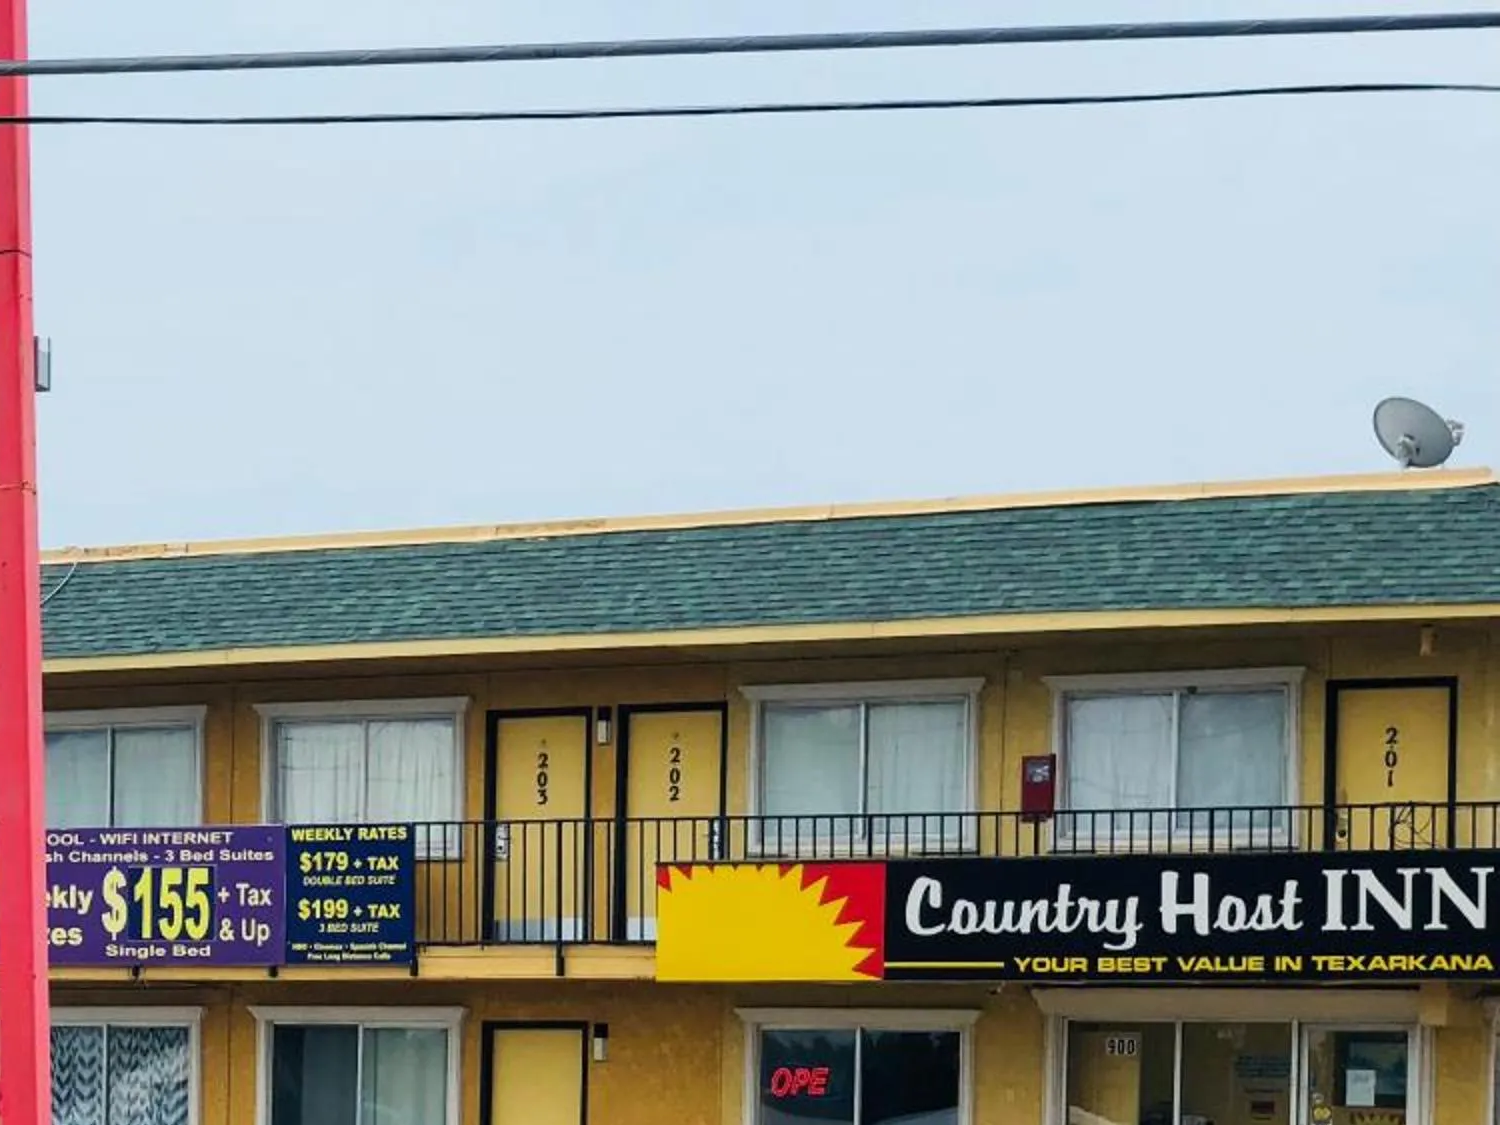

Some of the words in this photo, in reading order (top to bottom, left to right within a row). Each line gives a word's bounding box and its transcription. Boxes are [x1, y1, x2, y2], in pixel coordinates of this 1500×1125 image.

[1385, 727, 1398, 787] 201
[537, 753, 549, 805] 203
[669, 747, 681, 802] 202
[47, 833, 84, 846] OOL
[100, 833, 138, 845] WIFI
[143, 831, 234, 845] INTERNET
[291, 827, 354, 842] WEEKLY
[357, 826, 407, 840] RATES
[68, 850, 149, 863] Channels
[164, 850, 175, 862] 3
[179, 849, 214, 862] Bed
[219, 849, 274, 862] Suites
[299, 851, 349, 873] $179
[353, 858, 362, 869] +
[367, 855, 400, 871] TAX
[303, 875, 343, 886] DOUBLE
[344, 875, 366, 885] BED
[367, 875, 397, 885] SUITE
[47, 884, 94, 915] kly
[101, 865, 211, 941] $155
[218, 887, 231, 903] +
[235, 883, 273, 907] Tax
[298, 897, 349, 921] $199
[353, 905, 363, 917] +
[367, 903, 401, 918] TAX
[905, 875, 1143, 951] Country
[1159, 870, 1303, 935] Host
[1320, 866, 1495, 931] INN
[219, 917, 235, 941] &
[241, 918, 271, 946] Up
[350, 922, 380, 933] SUITE
[105, 943, 167, 959] Single
[172, 943, 211, 957] Bed
[1013, 956, 1089, 974] YOUR
[1097, 956, 1167, 974] BEST
[1177, 955, 1265, 974] VALUE
[1274, 955, 1302, 973] IN
[1311, 953, 1494, 972] TEXARKANA
[1107, 1039, 1136, 1055] 900
[771, 1067, 830, 1097] OPE
